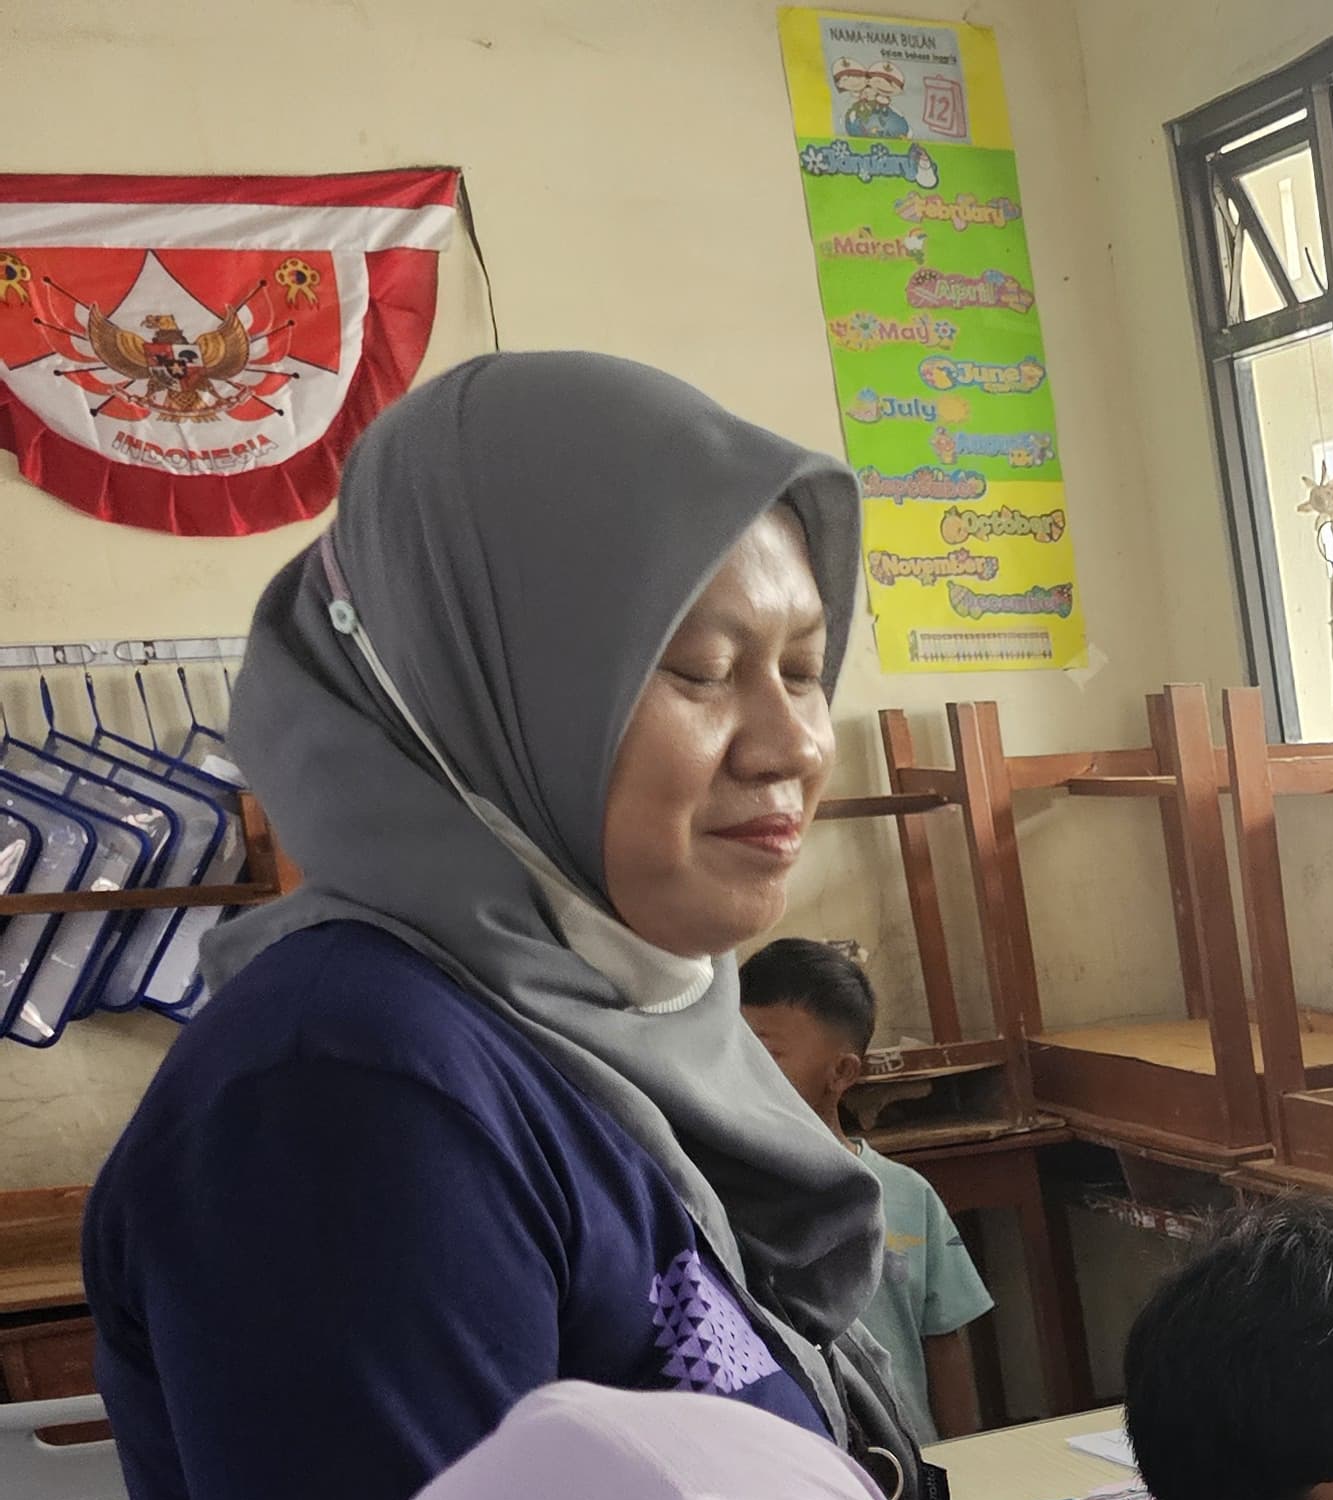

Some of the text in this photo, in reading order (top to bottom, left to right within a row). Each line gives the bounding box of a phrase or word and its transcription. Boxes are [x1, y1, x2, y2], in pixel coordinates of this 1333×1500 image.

[829, 28, 937, 48] NAMA-NAMA BULAN
[928, 97, 949, 122] 12
[827, 153, 918, 181] January
[833, 236, 910, 257] March
[935, 281, 996, 307] April
[878, 323, 930, 344] May
[958, 363, 1020, 385] June
[880, 398, 937, 422] July
[111, 431, 279, 475] INDONESIA
[962, 511, 1054, 537] October
[883, 555, 986, 578] November
